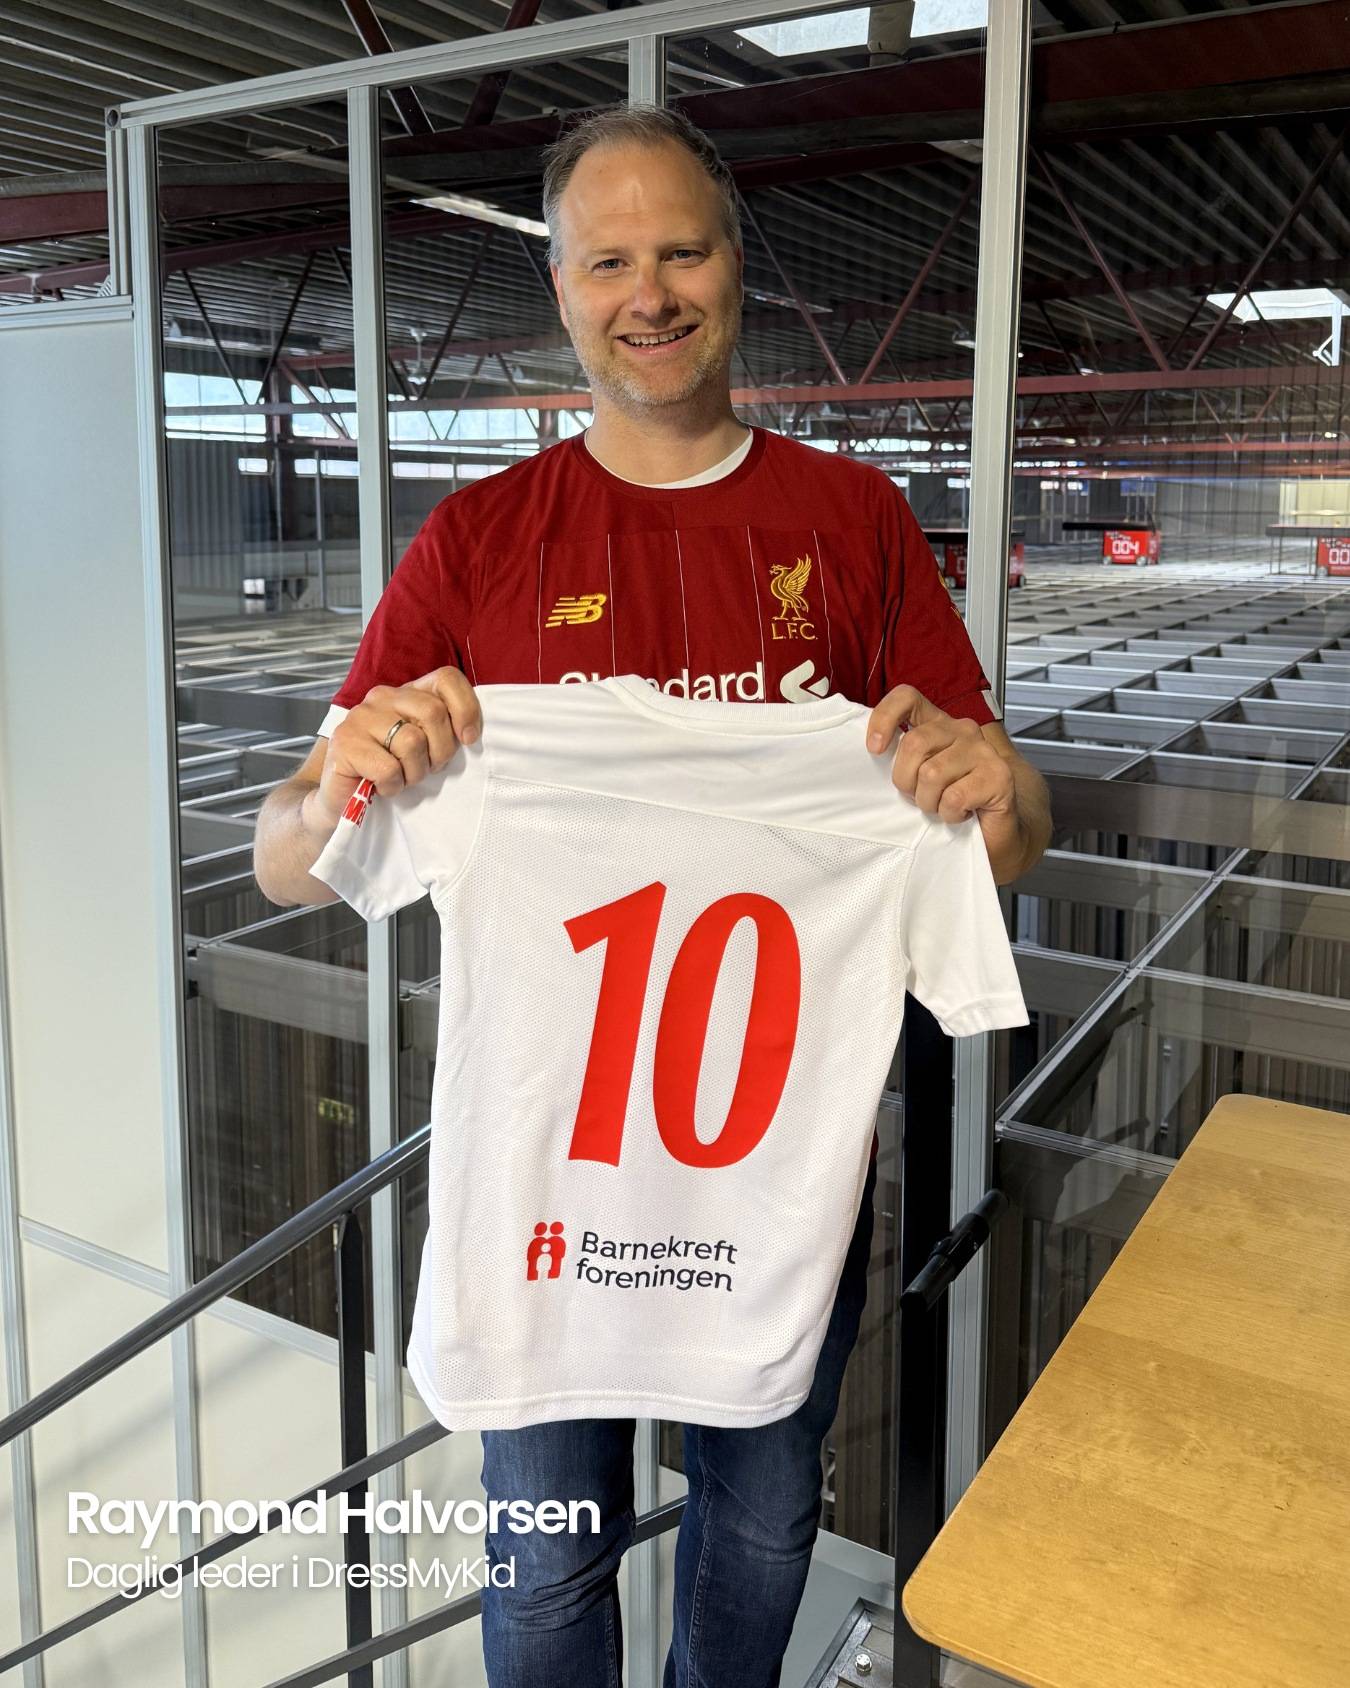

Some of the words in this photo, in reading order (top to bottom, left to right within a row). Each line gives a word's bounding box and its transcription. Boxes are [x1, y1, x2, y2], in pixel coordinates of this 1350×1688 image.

[1112, 540, 1140, 555] 004
[771, 622, 818, 640] L.F.C.
[559, 661, 765, 703] dard
[563, 880, 802, 1169] 10
[580, 1230, 738, 1265] Barnekreft
[576, 1257, 733, 1292] foreningen
